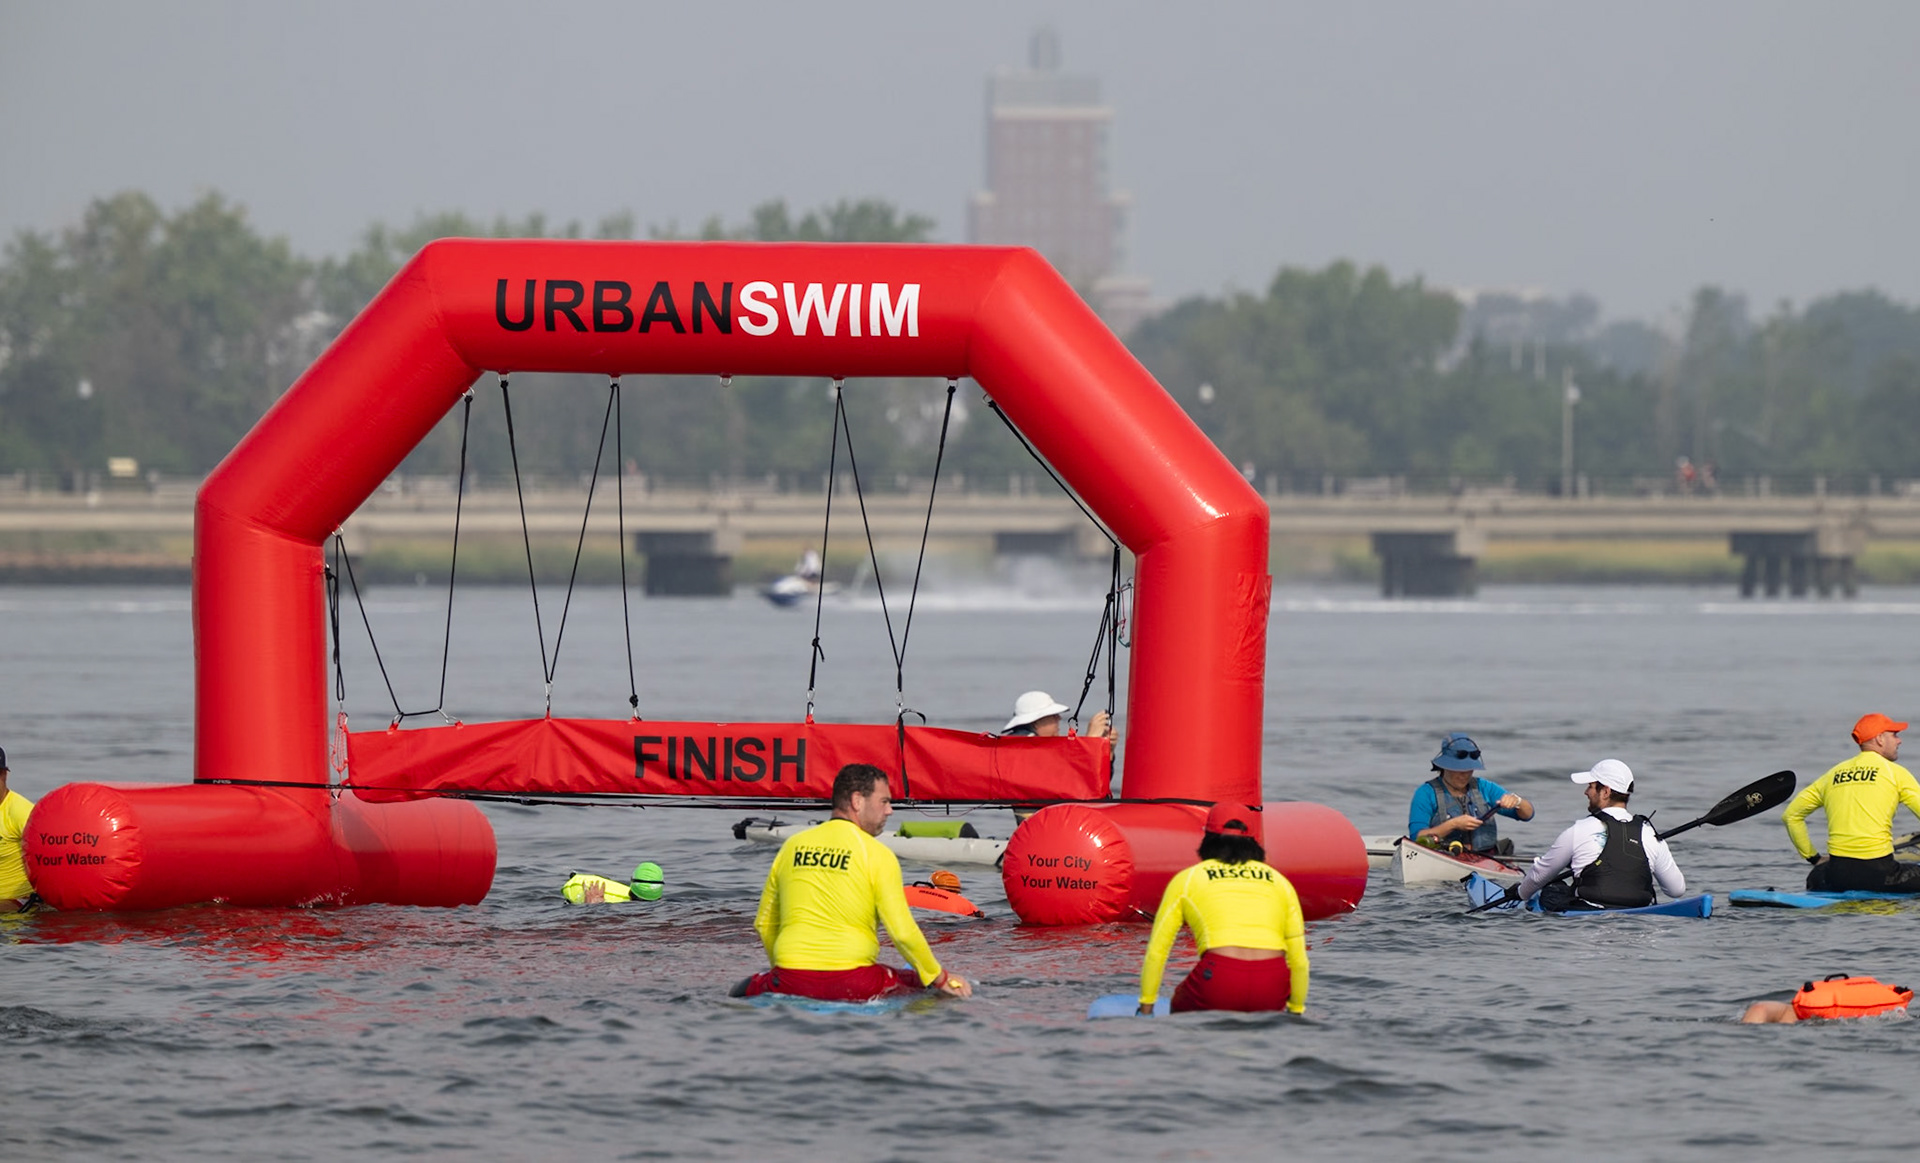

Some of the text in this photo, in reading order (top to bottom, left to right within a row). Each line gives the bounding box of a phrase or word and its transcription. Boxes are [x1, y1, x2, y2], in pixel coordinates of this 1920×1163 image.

[494, 278, 921, 337] URBANSWIM
[634, 735, 807, 783] FINISH
[1832, 770, 1879, 786] RESCUE
[39, 832, 99, 848] Your City
[34, 852, 107, 866] Your Water
[793, 851, 851, 871] RESCUE
[1027, 853, 1092, 872] Your City
[1021, 875, 1099, 890] Your Water
[1206, 868, 1275, 883] RESCUE
